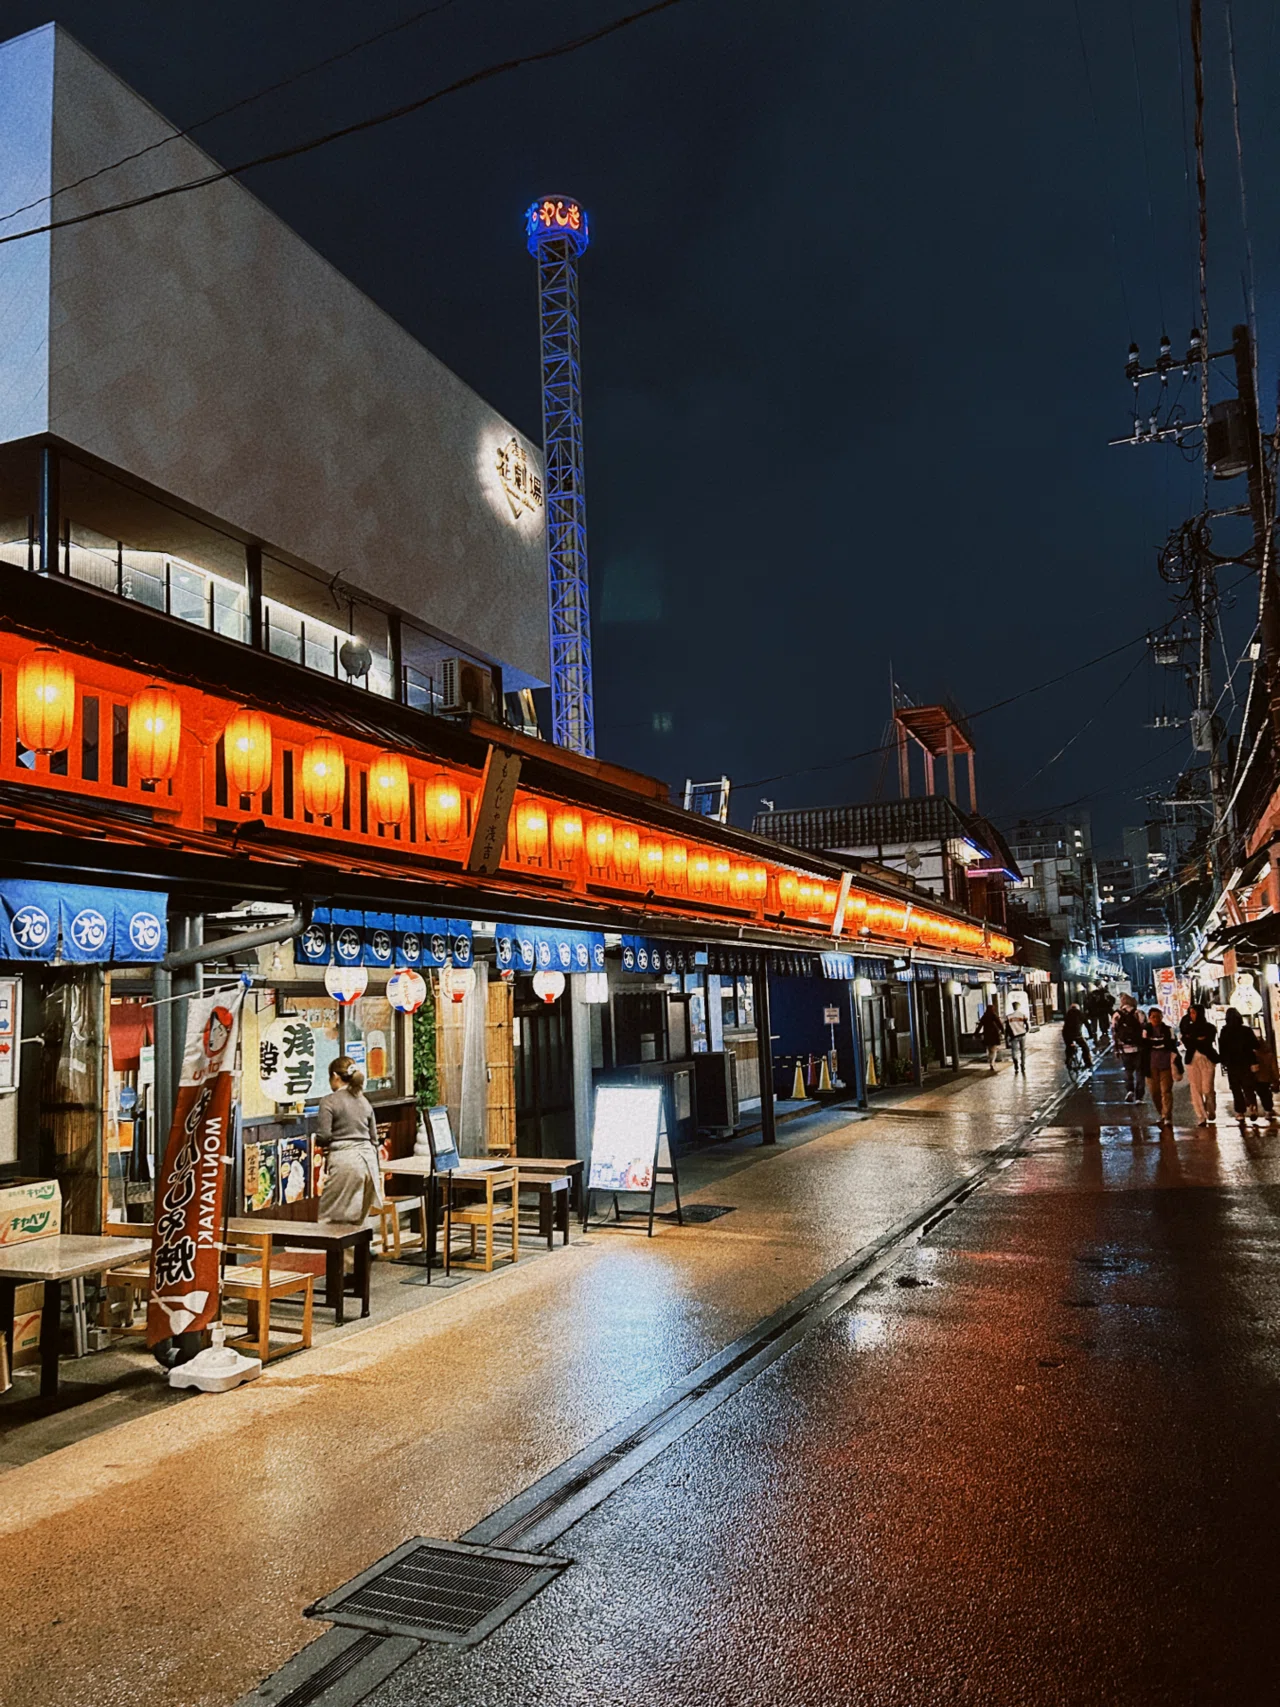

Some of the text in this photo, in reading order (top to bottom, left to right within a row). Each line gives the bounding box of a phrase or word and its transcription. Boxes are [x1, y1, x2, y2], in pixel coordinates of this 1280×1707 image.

[282, 1022, 315, 1096] 浅吉
[10, 1210, 51, 1234] キャベツ
